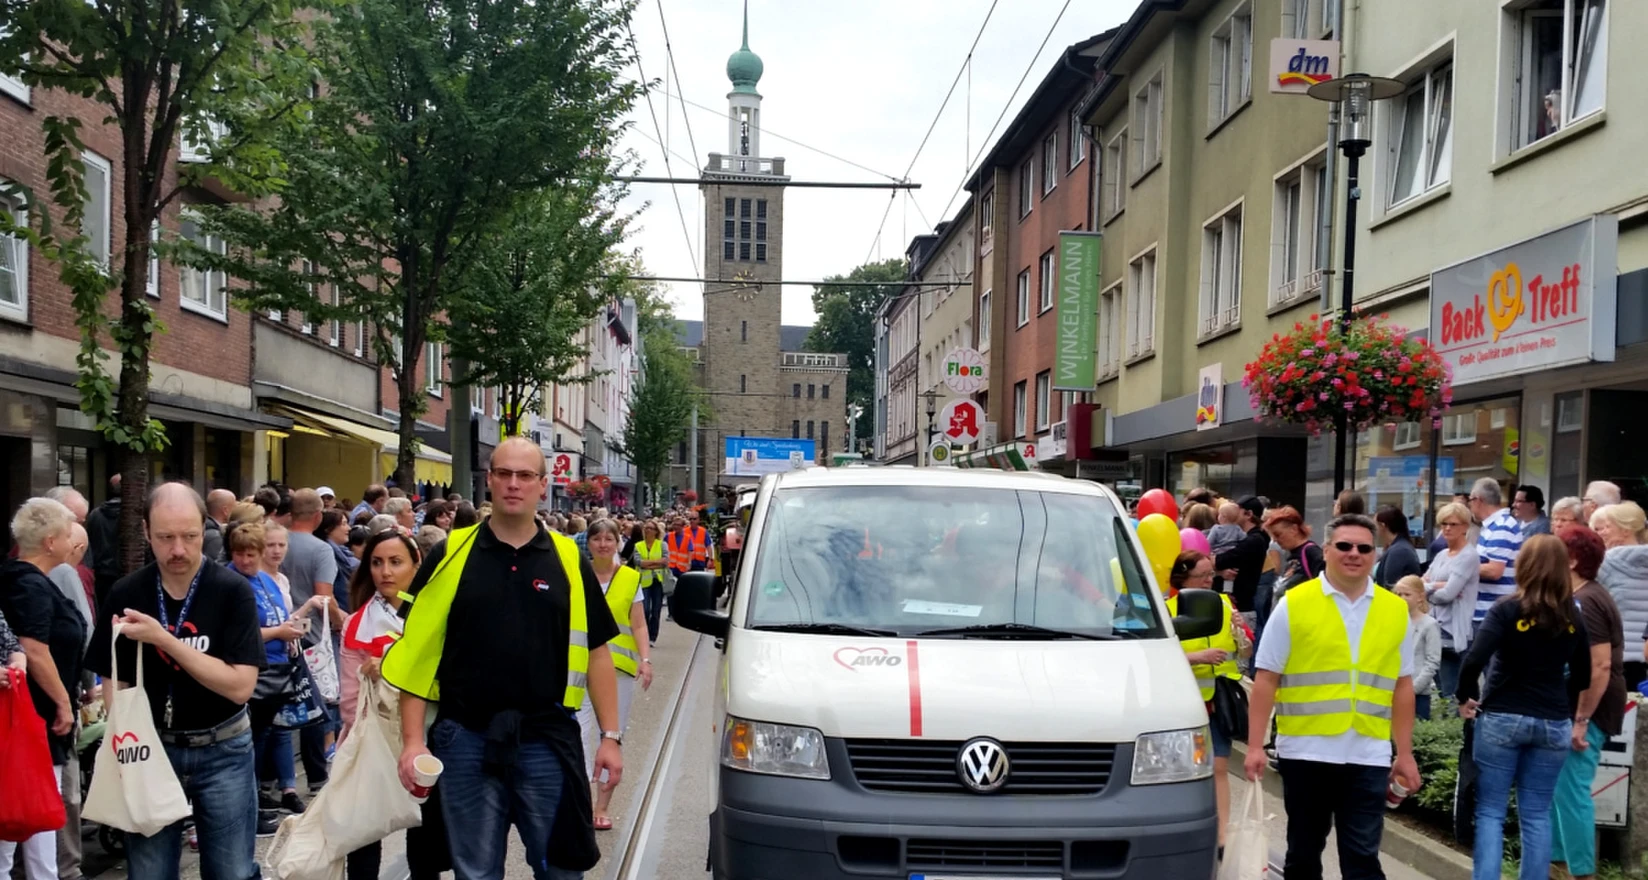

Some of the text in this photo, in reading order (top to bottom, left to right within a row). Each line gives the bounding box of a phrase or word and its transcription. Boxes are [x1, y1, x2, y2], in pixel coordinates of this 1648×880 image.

[1288, 47, 1329, 73] dm
[1060, 242, 1082, 380] WINKELMANN
[1441, 263, 1581, 346] Back Treff
[948, 362, 983, 376] Flora
[851, 655, 902, 667] AWO
[117, 745, 151, 764] AWO
